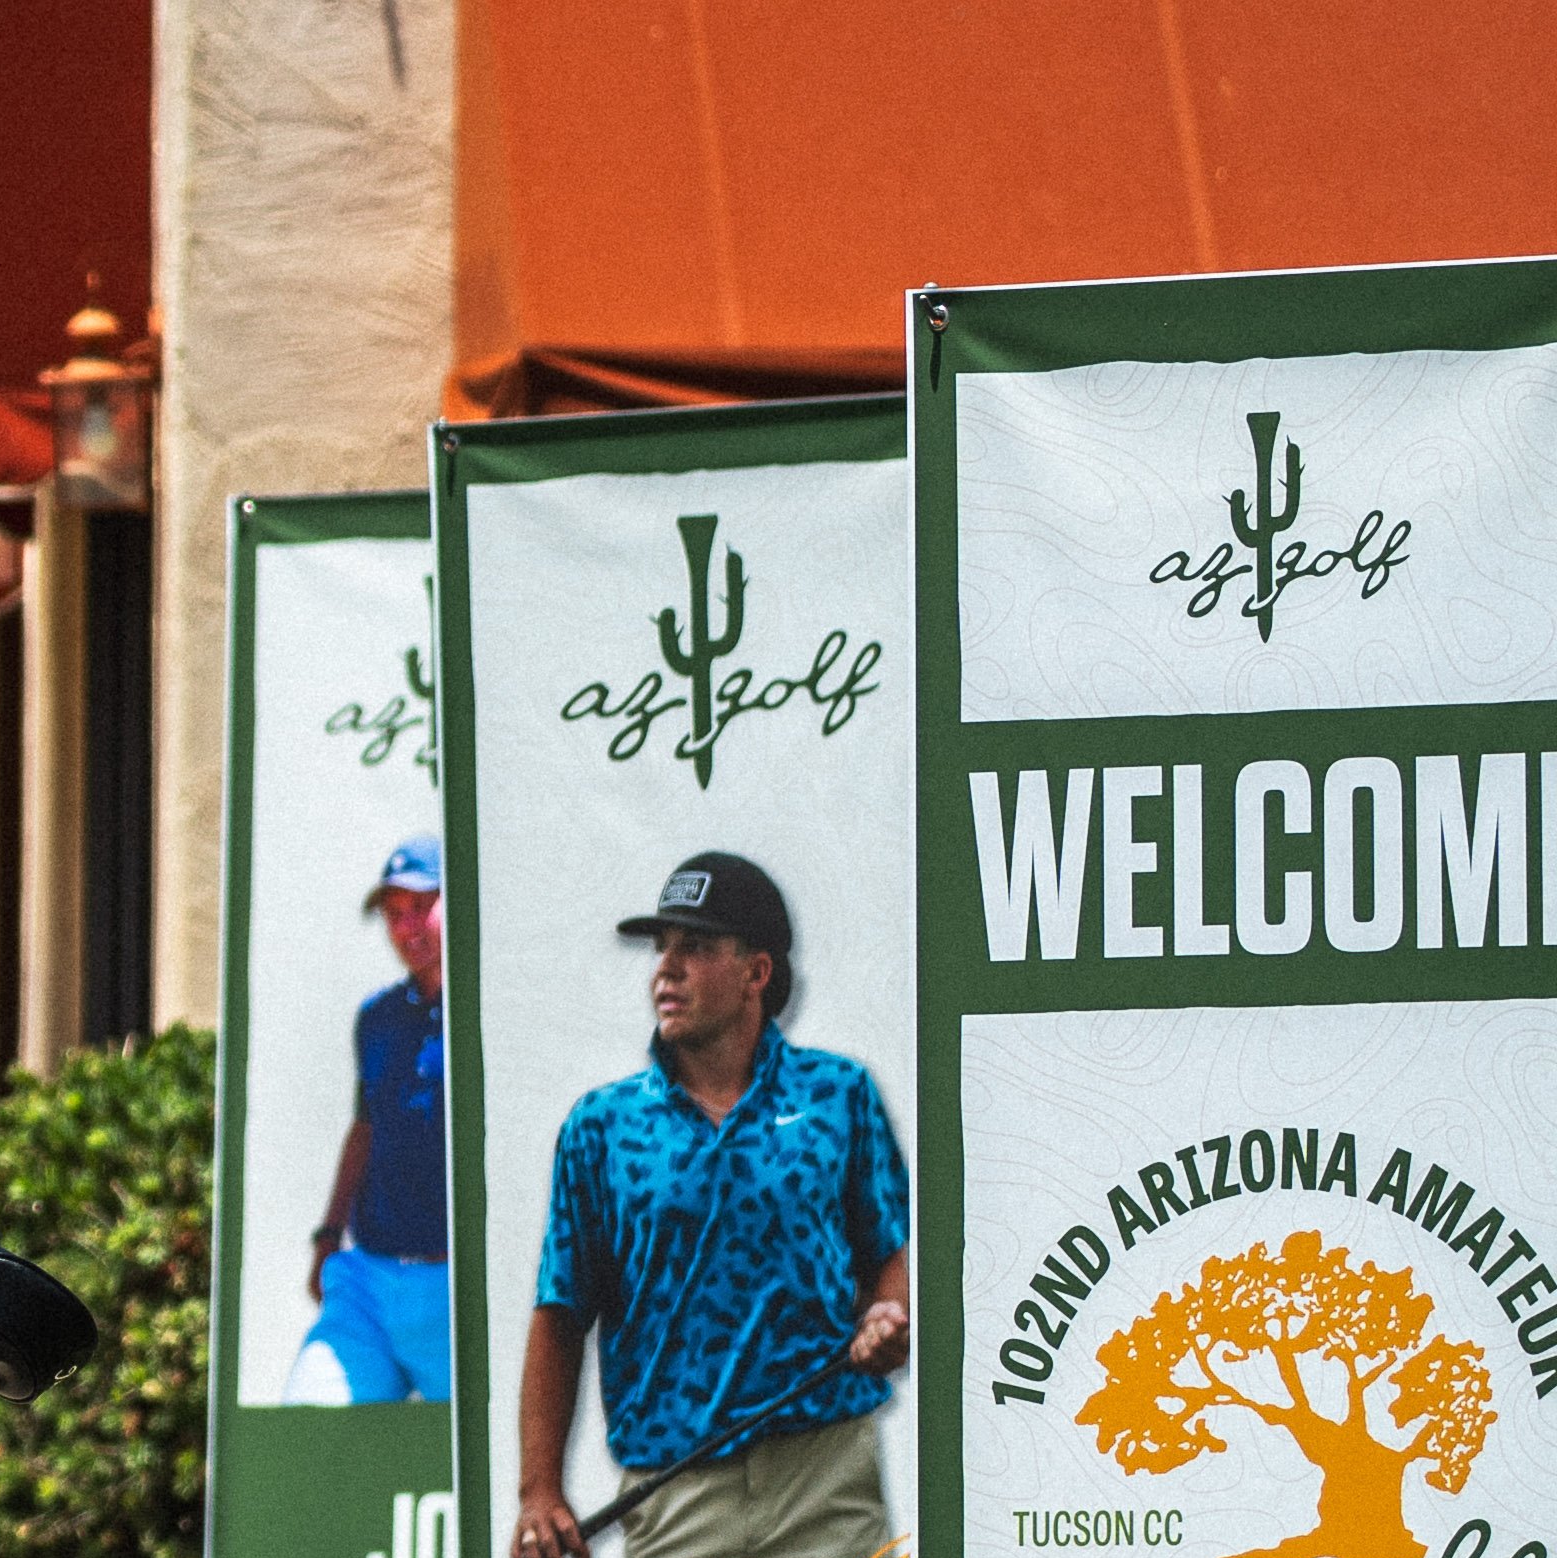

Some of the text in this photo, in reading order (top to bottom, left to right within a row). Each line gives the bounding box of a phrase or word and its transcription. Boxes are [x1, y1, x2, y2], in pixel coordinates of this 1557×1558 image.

[1149, 510, 1412, 617] az golf
[560, 631, 881, 761] az golf
[968, 752, 1557, 962] WELCOM
[991, 1225, 1112, 1406] 102ND
[1106, 1127, 1358, 1250] ARIZONA
[1013, 1510, 1183, 1547] TUCSON CC
